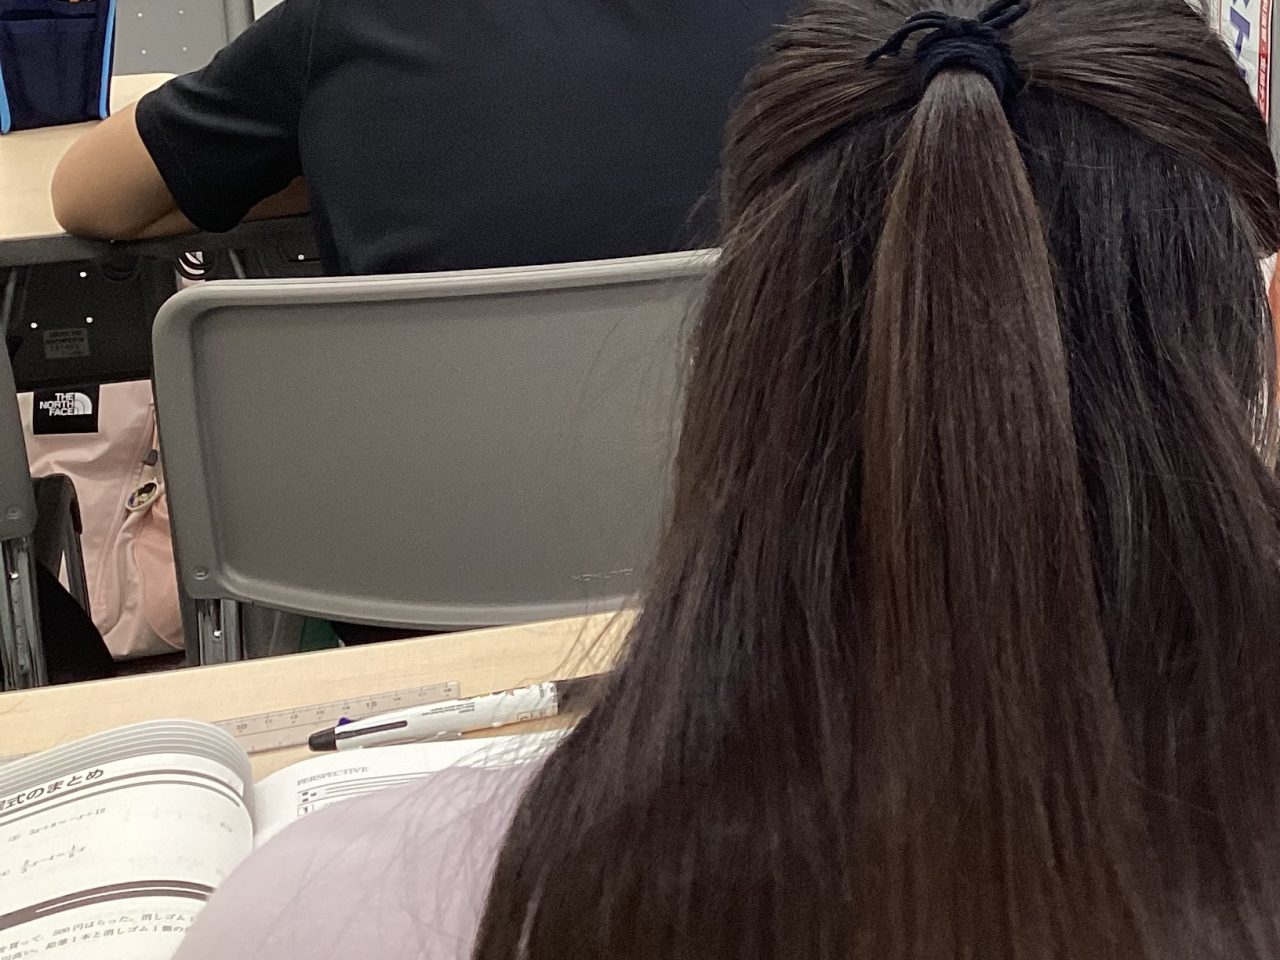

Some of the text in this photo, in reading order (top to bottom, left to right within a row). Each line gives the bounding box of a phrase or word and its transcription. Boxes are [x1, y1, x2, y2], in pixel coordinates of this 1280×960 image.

[55, 392, 75, 401] THE
[40, 400, 75, 410] NORTH
[49, 407, 75, 416] FACE
